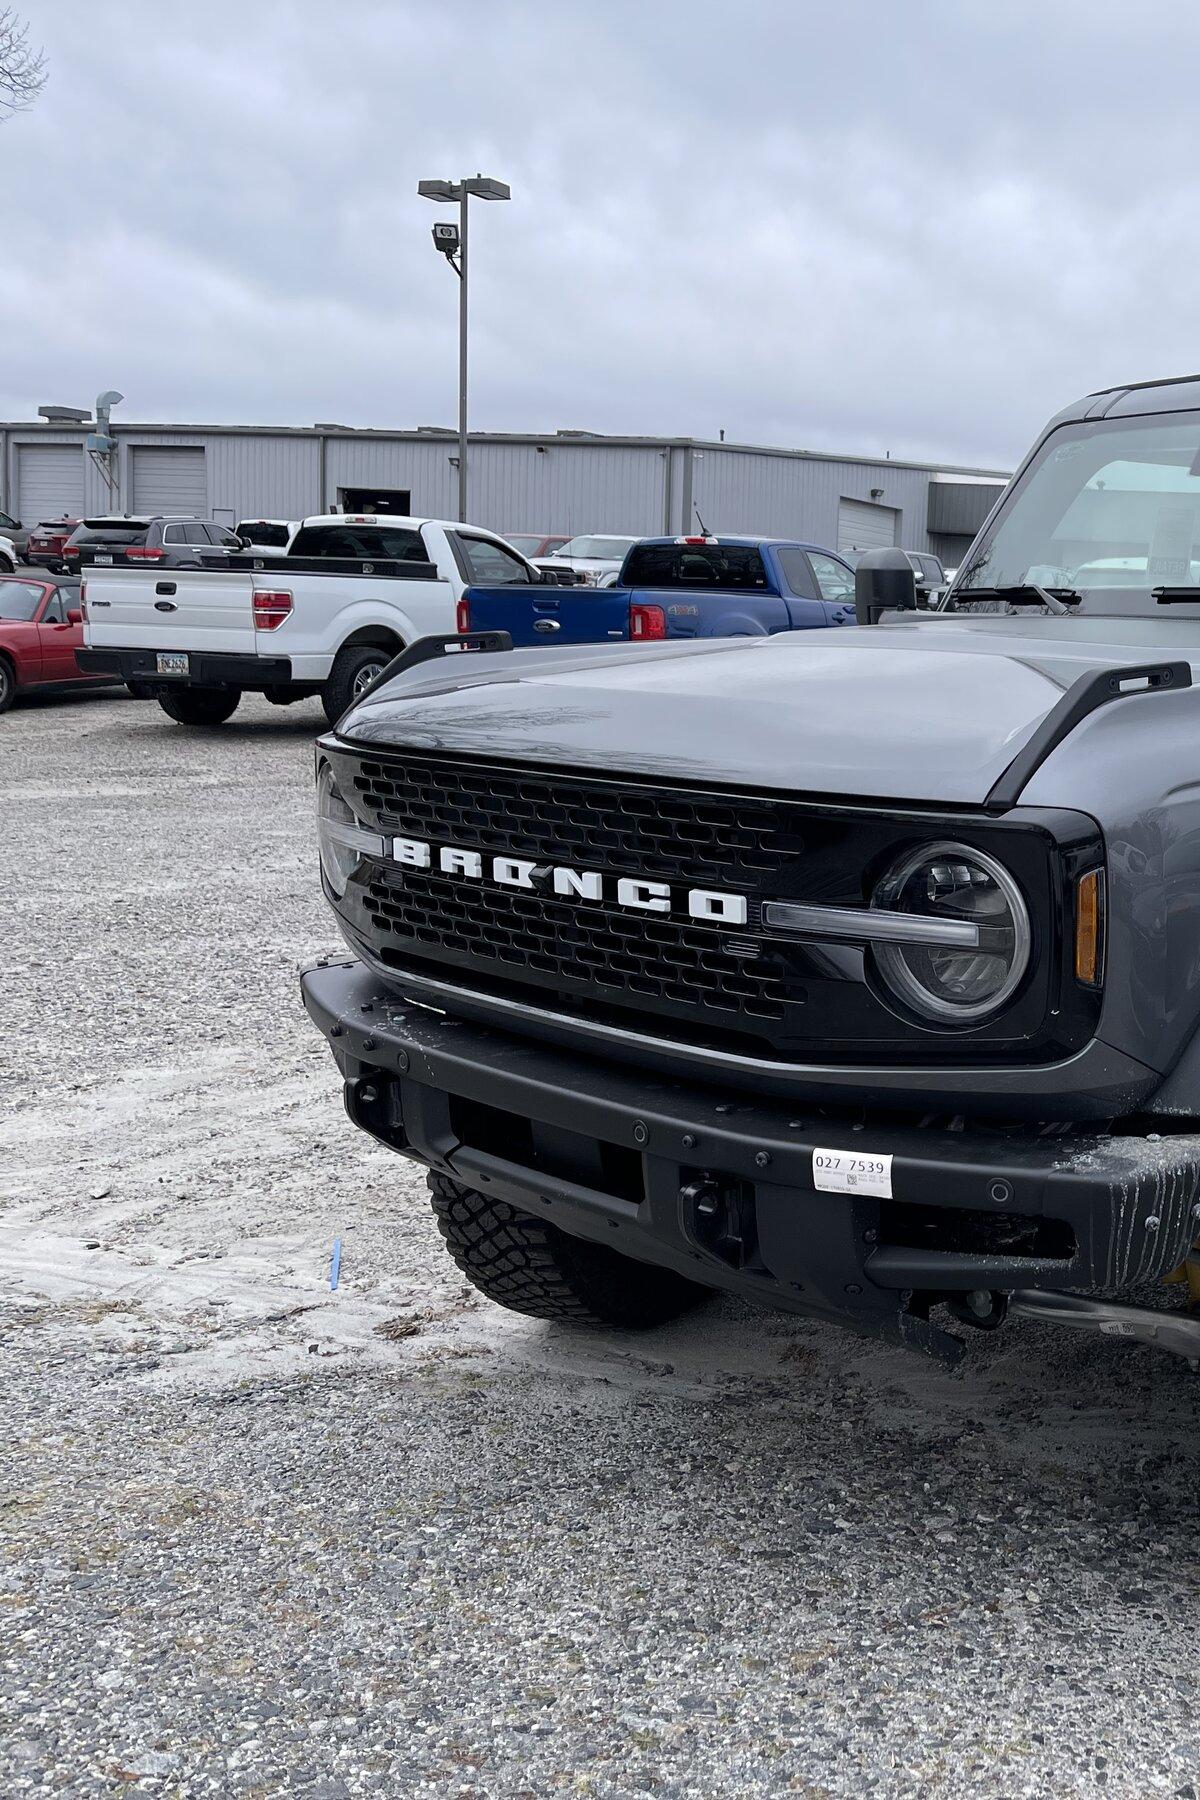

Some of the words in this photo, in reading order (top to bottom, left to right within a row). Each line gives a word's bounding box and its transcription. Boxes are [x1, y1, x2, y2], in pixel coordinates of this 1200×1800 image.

[392, 837, 748, 925] BRONCO
[815, 1156, 841, 1169] 027
[849, 1159, 884, 1174] 7539
